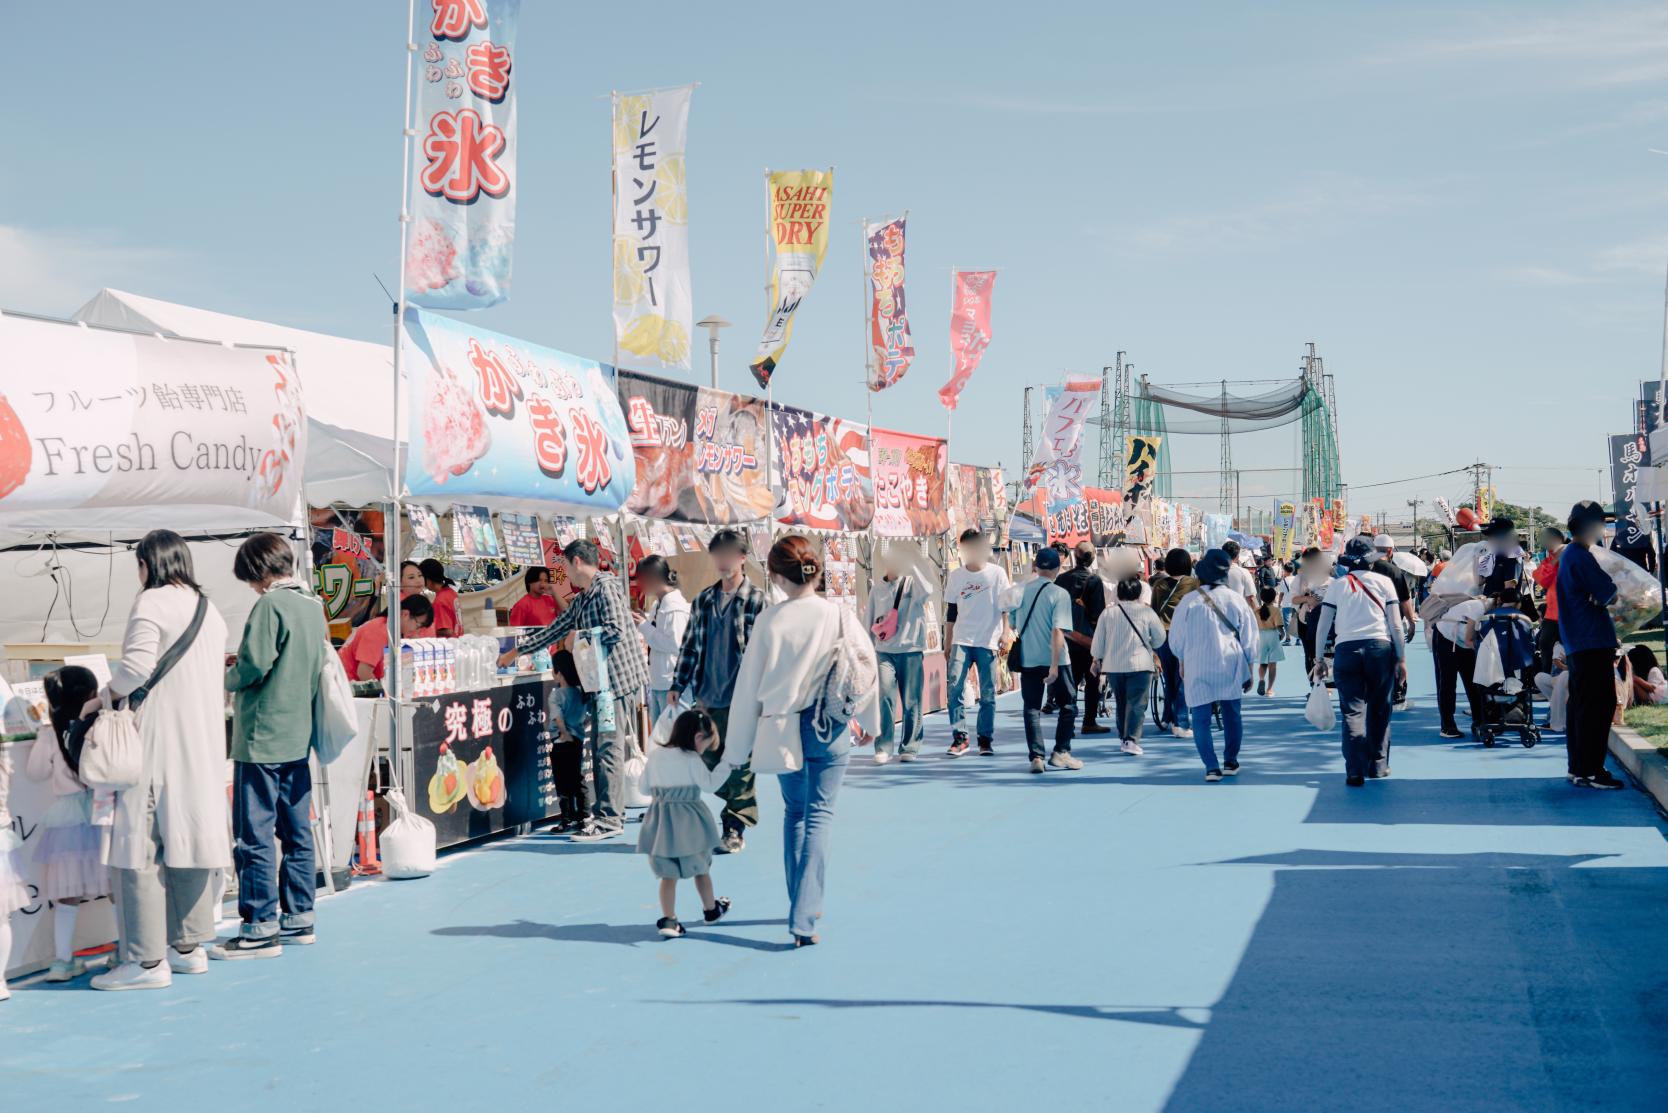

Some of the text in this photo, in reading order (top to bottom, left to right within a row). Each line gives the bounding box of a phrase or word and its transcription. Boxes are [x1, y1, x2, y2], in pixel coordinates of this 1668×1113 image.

[631, 110, 662, 307] レモンサワー
[33, 382, 248, 416] フルーツ飴専門店
[467, 337, 612, 495] かき氷
[36, 430, 263, 481] Fresh Candy
[697, 440, 758, 476] レモンサワー
[873, 470, 930, 510] たこやき
[444, 697, 514, 744] 究極の
